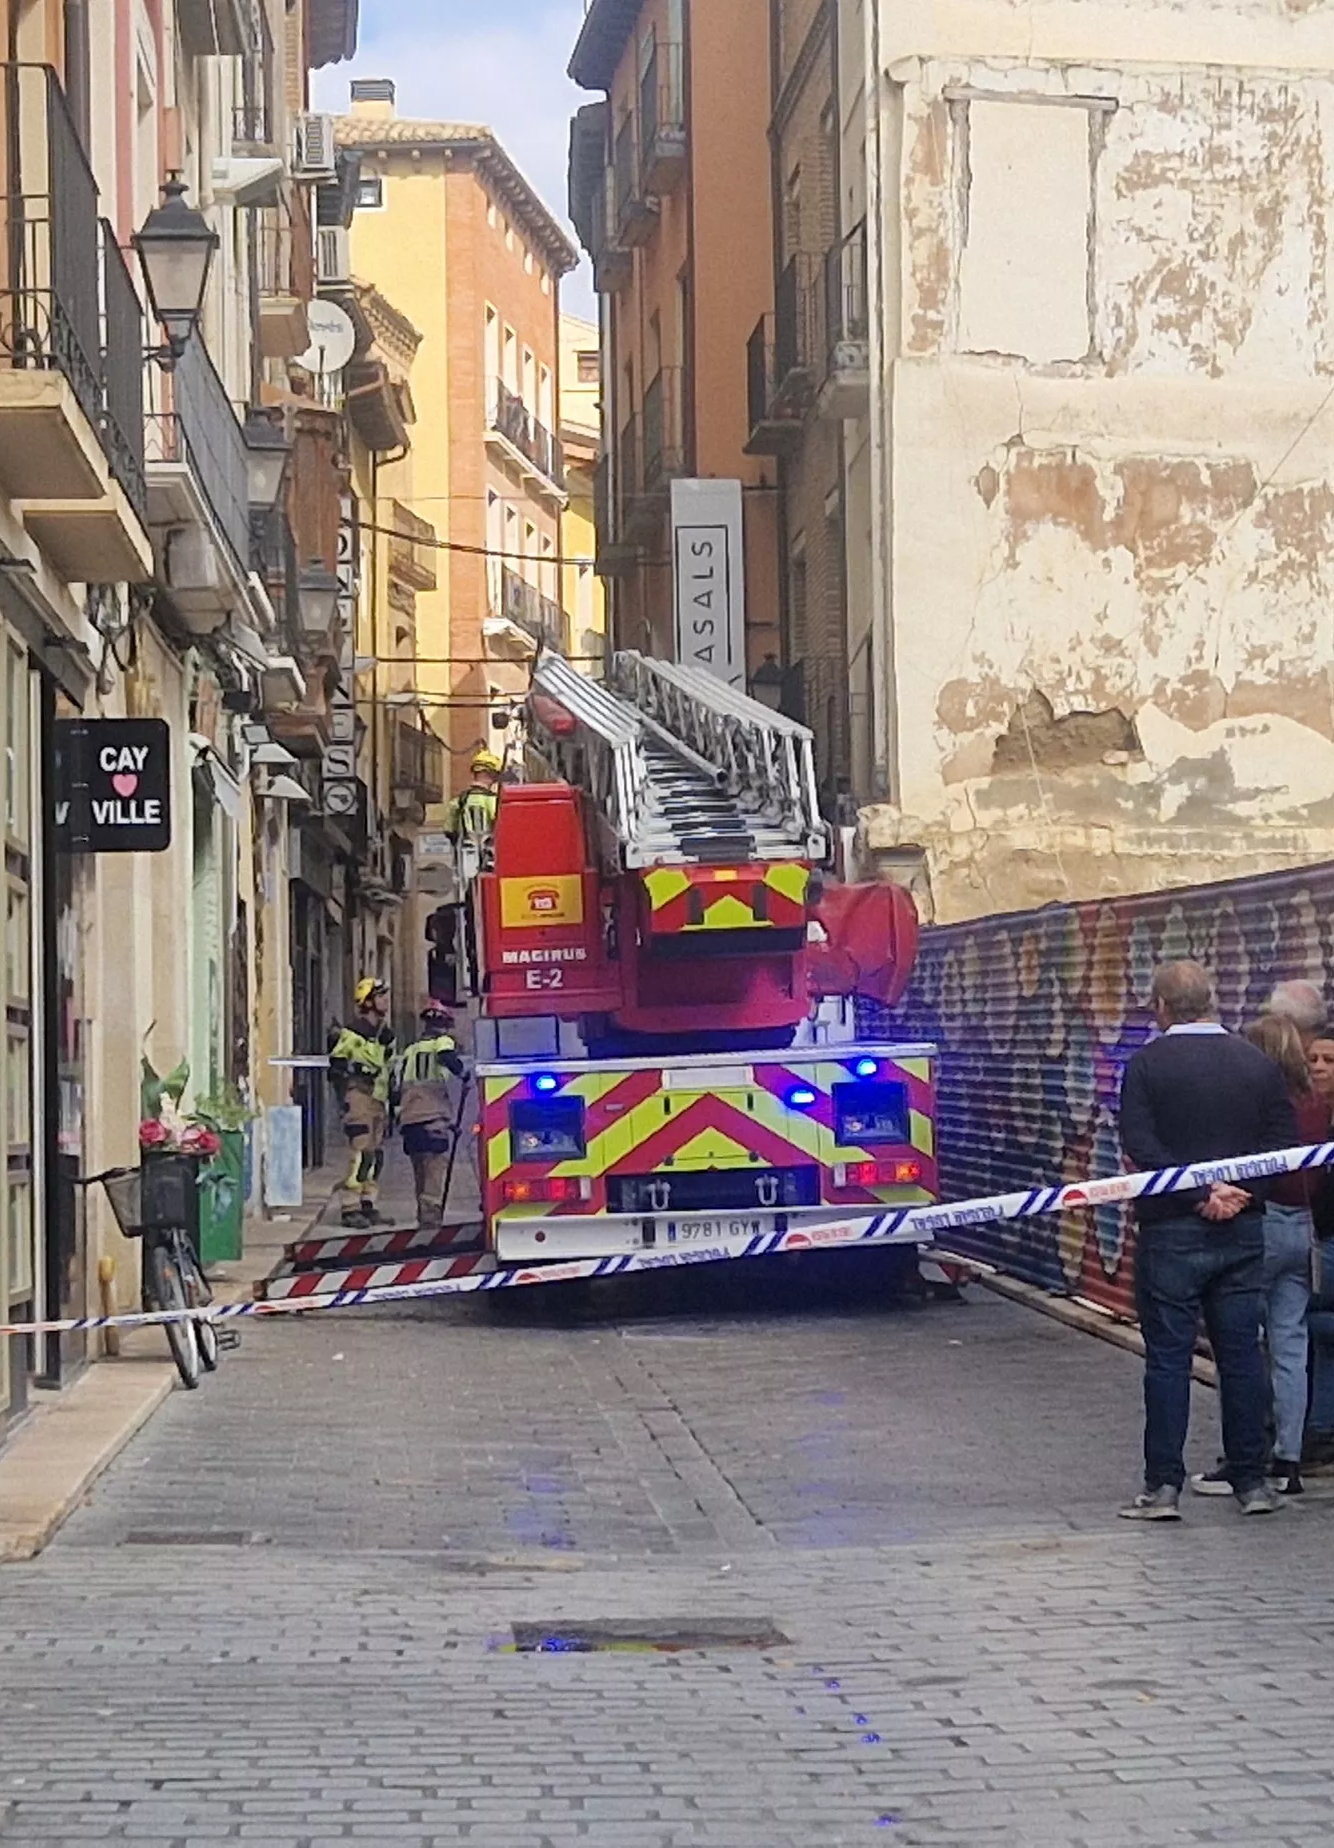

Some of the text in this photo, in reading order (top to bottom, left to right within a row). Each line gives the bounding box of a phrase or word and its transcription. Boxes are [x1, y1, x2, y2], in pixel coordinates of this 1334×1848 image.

[691, 540, 715, 664] ASALS
[100, 746, 149, 772] CAY
[91, 799, 162, 825] VILLE
[502, 948, 587, 964] MAGIRUS
[526, 968, 563, 989] E-2
[681, 1219, 760, 1240] 9781 GYW
